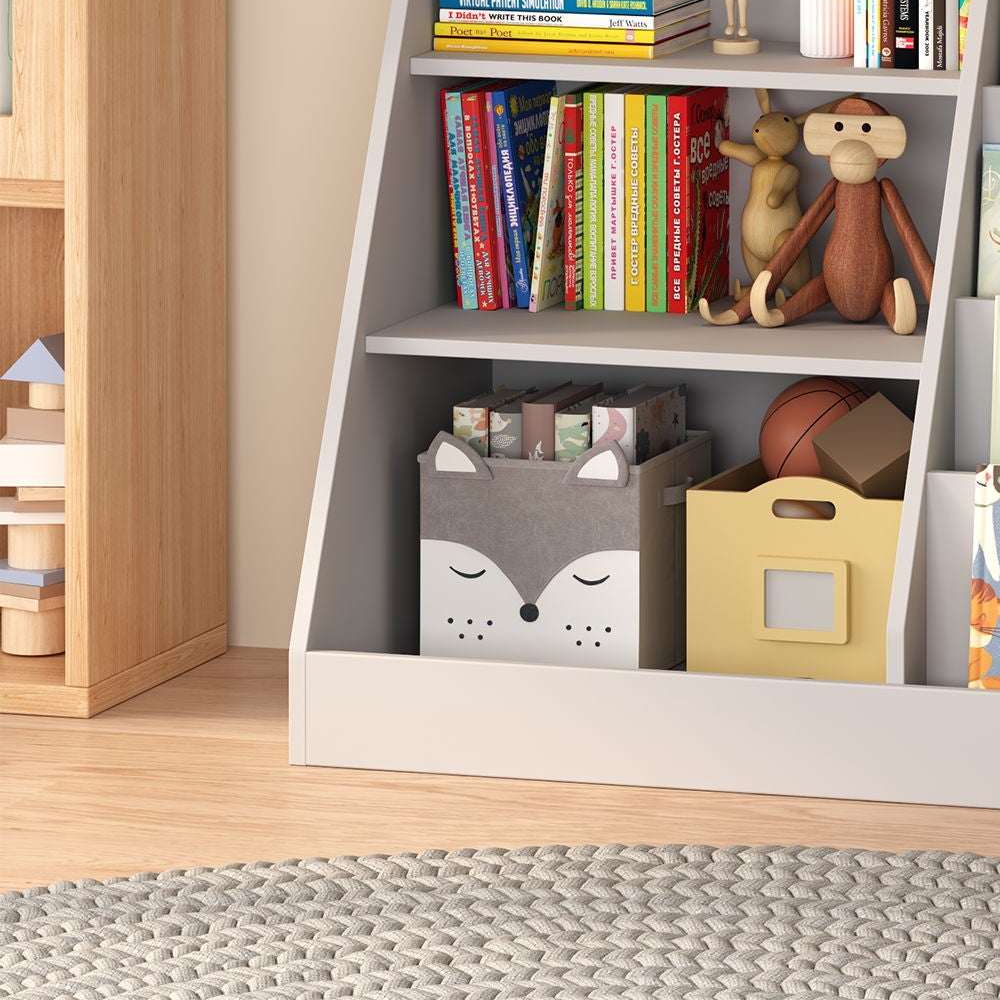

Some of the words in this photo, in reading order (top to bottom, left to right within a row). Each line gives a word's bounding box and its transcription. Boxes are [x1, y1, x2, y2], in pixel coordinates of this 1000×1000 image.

[448, 11, 453, 19] I
[455, 11, 486, 20] Didn't
[488, 13, 515, 21] WRITE
[517, 14, 537, 22] THIS
[450, 26, 472, 36] Poet
[490, 27, 512, 37] Poet
[608, 19, 624, 29] Jeff
[625, 20, 648, 28] Watts
[589, 94, 597, 127] ВРЕДНЫЕ
[630, 127, 639, 177] СОВЕТЫ
[673, 112, 681, 166] Г.ОСТЕРА
[465, 125, 476, 180] ВОПРОСАХ
[471, 196, 481, 242] ОТВЕТАХ
[500, 149, 520, 228] ЭНЦИКЛОПЕДИЯ
[673, 169, 681, 215] СОВЕТЫ
[630, 179, 640, 236] ВРЕДНЫЕ
[589, 224, 598, 269] ВОСПИТАНИЕ
[630, 239, 639, 277] ОСТЕР
[673, 218, 682, 272] ВРЕДНЫЕ
[589, 270, 598, 307] ВЗРОСЛЫХ
[673, 278, 681, 300] ВСЕ
